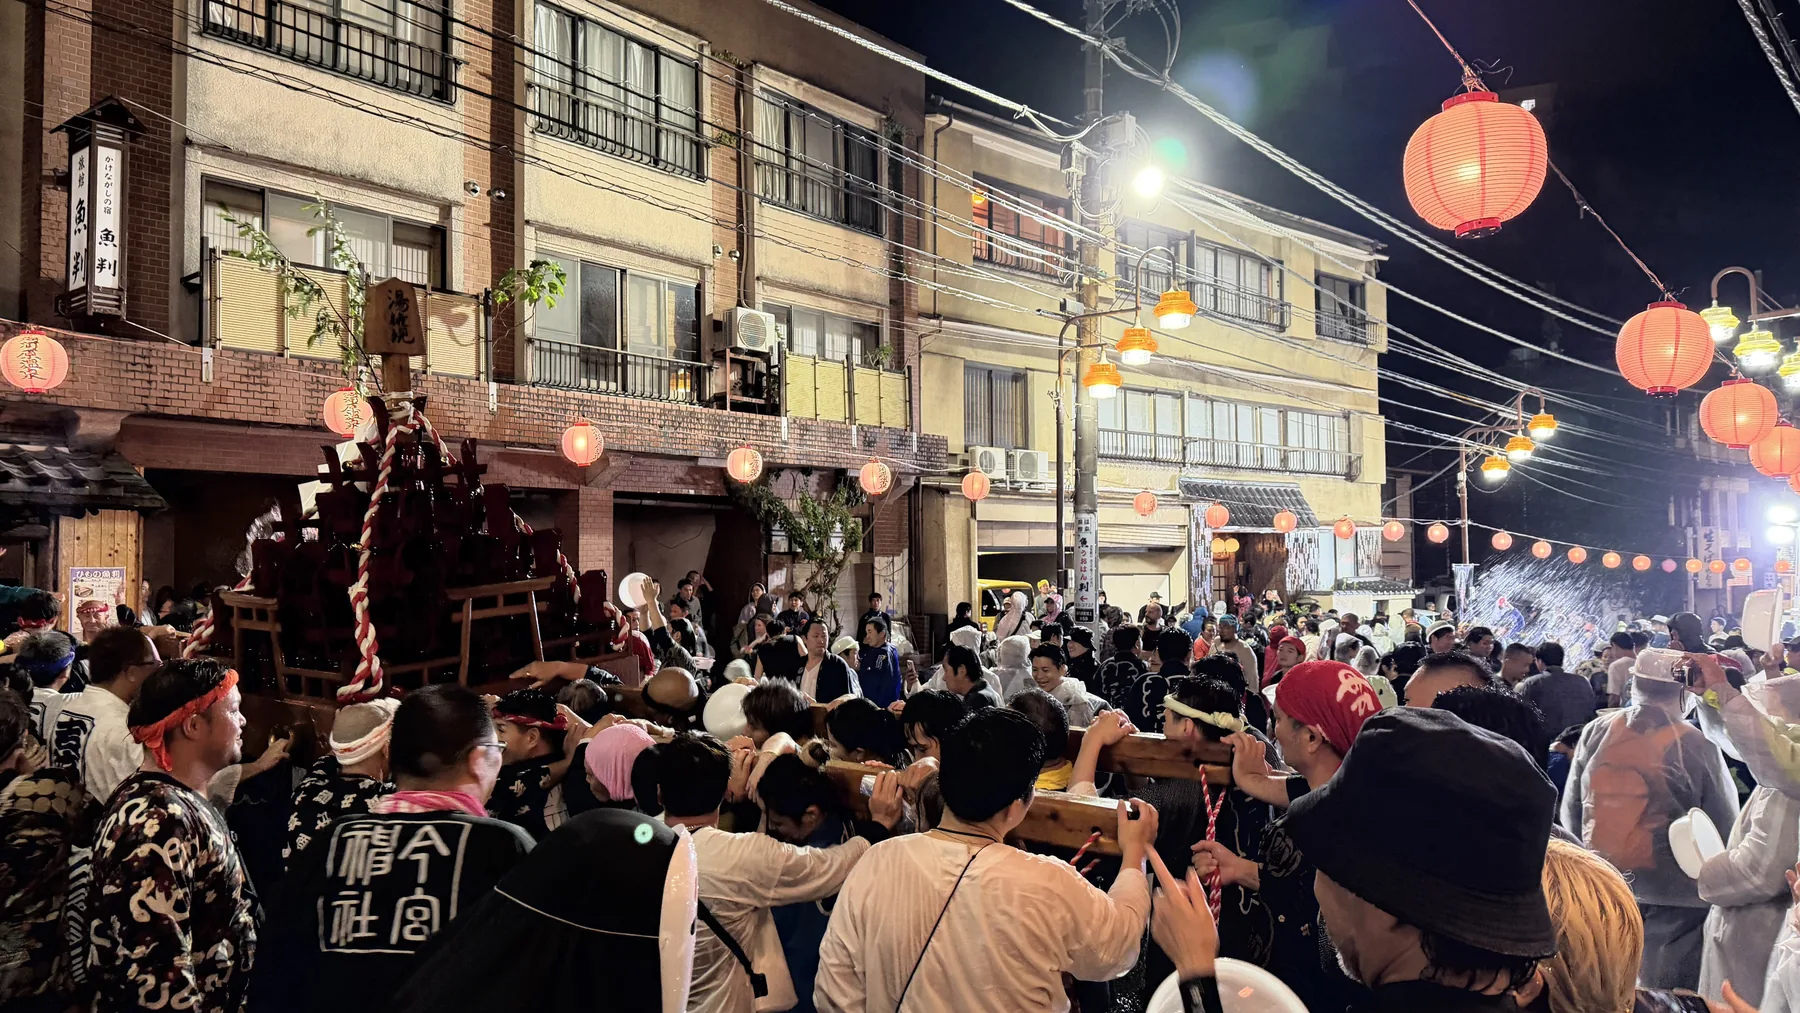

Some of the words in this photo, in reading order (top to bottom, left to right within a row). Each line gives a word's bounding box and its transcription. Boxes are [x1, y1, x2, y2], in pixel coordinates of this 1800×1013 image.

[104, 155, 114, 215] かけながしの宿
[73, 197, 88, 285] 魚判
[96, 227, 118, 277] 魚判
